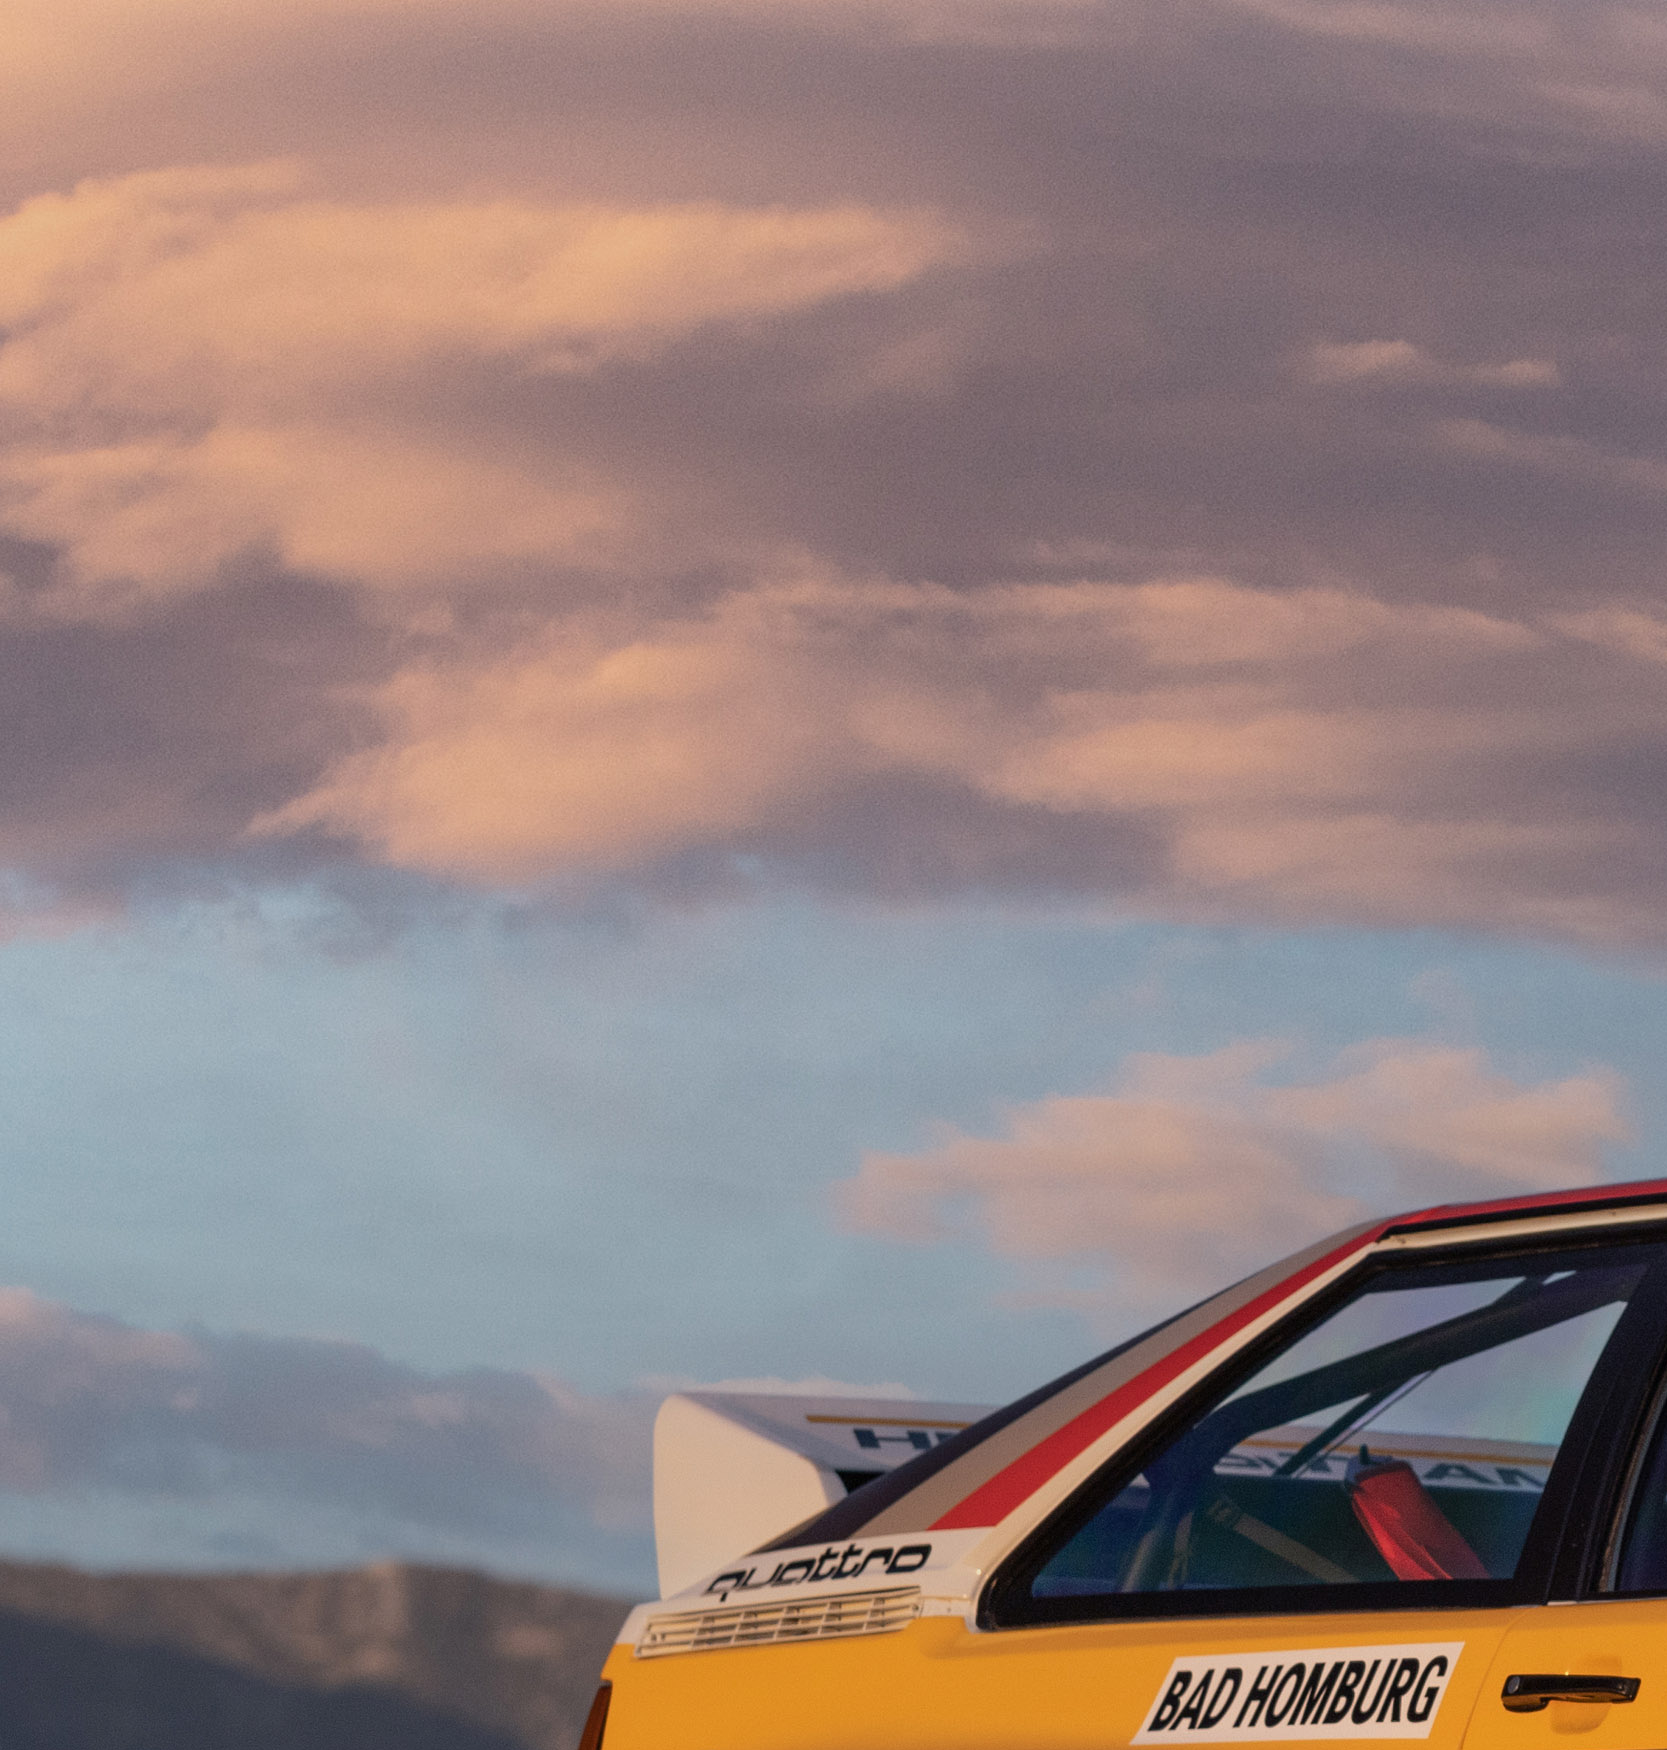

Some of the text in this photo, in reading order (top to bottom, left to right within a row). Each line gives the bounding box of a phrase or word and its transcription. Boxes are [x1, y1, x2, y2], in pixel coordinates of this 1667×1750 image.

[701, 1544, 932, 1602] quattro
[1147, 1655, 1448, 1732] BAD HOMBURG
